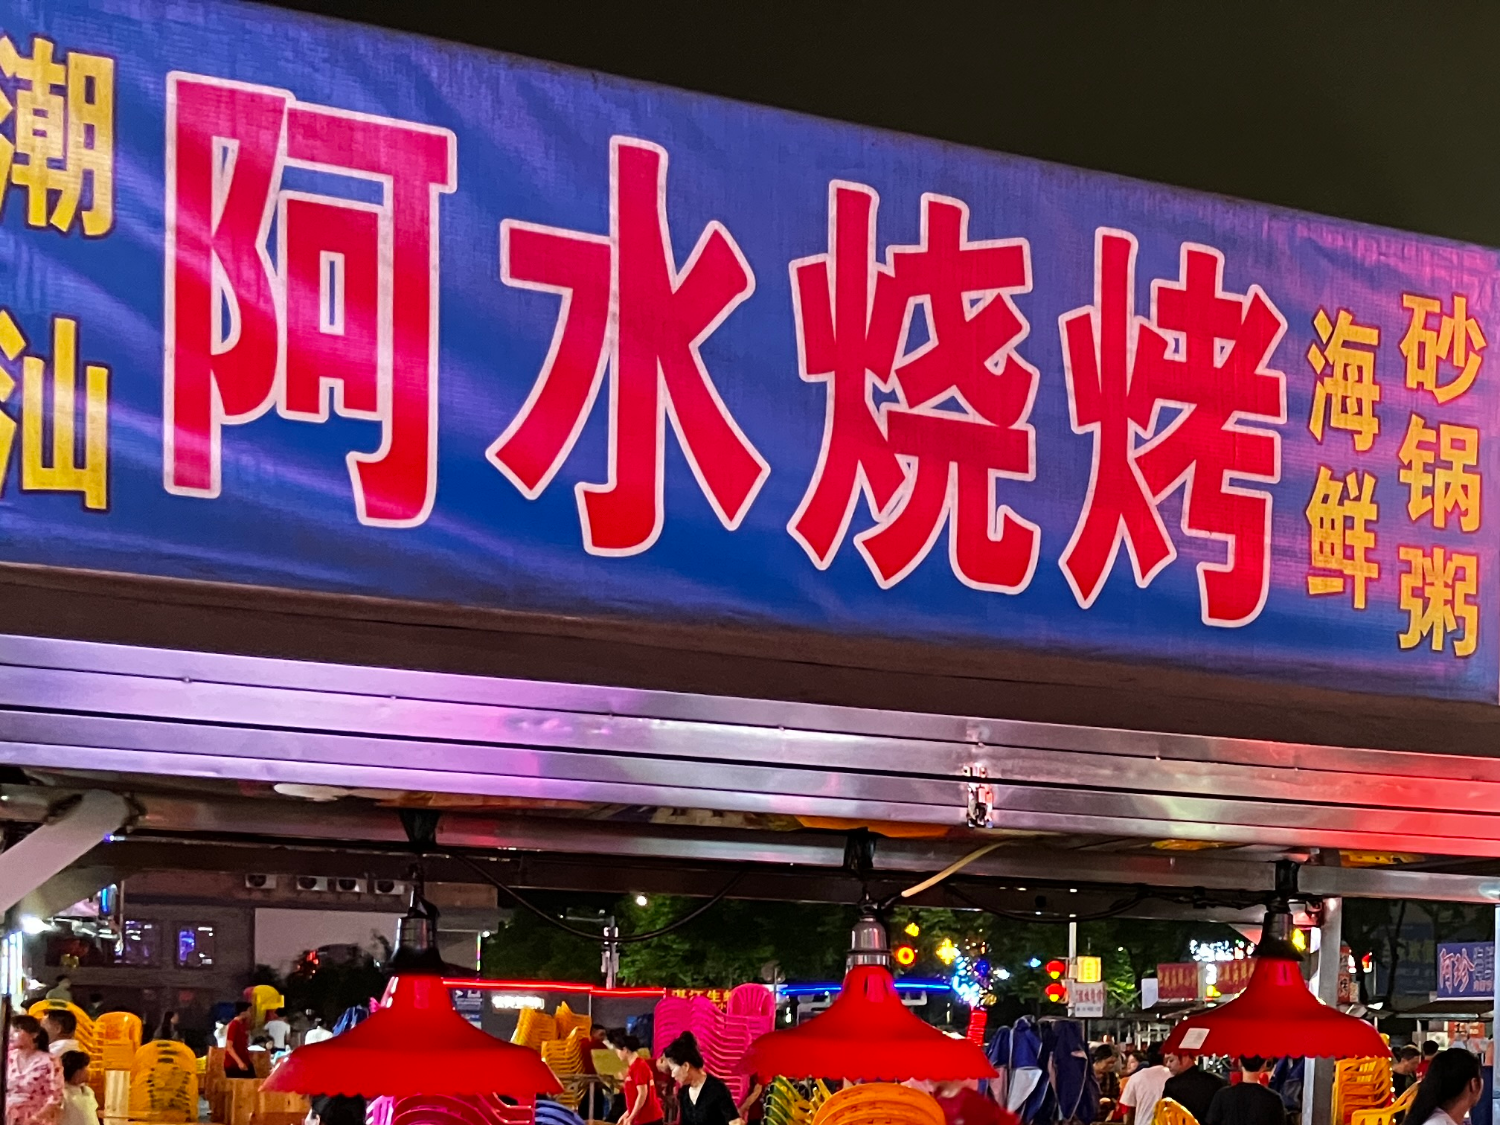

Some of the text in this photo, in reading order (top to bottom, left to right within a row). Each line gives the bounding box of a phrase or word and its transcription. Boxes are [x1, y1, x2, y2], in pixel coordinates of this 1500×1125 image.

[0, 36, 116, 512] 潮汕
[163, 70, 1289, 628] 阿水烧烤
[1306, 308, 1382, 612] 海鲜
[1398, 292, 1486, 658] 砂锅粥
